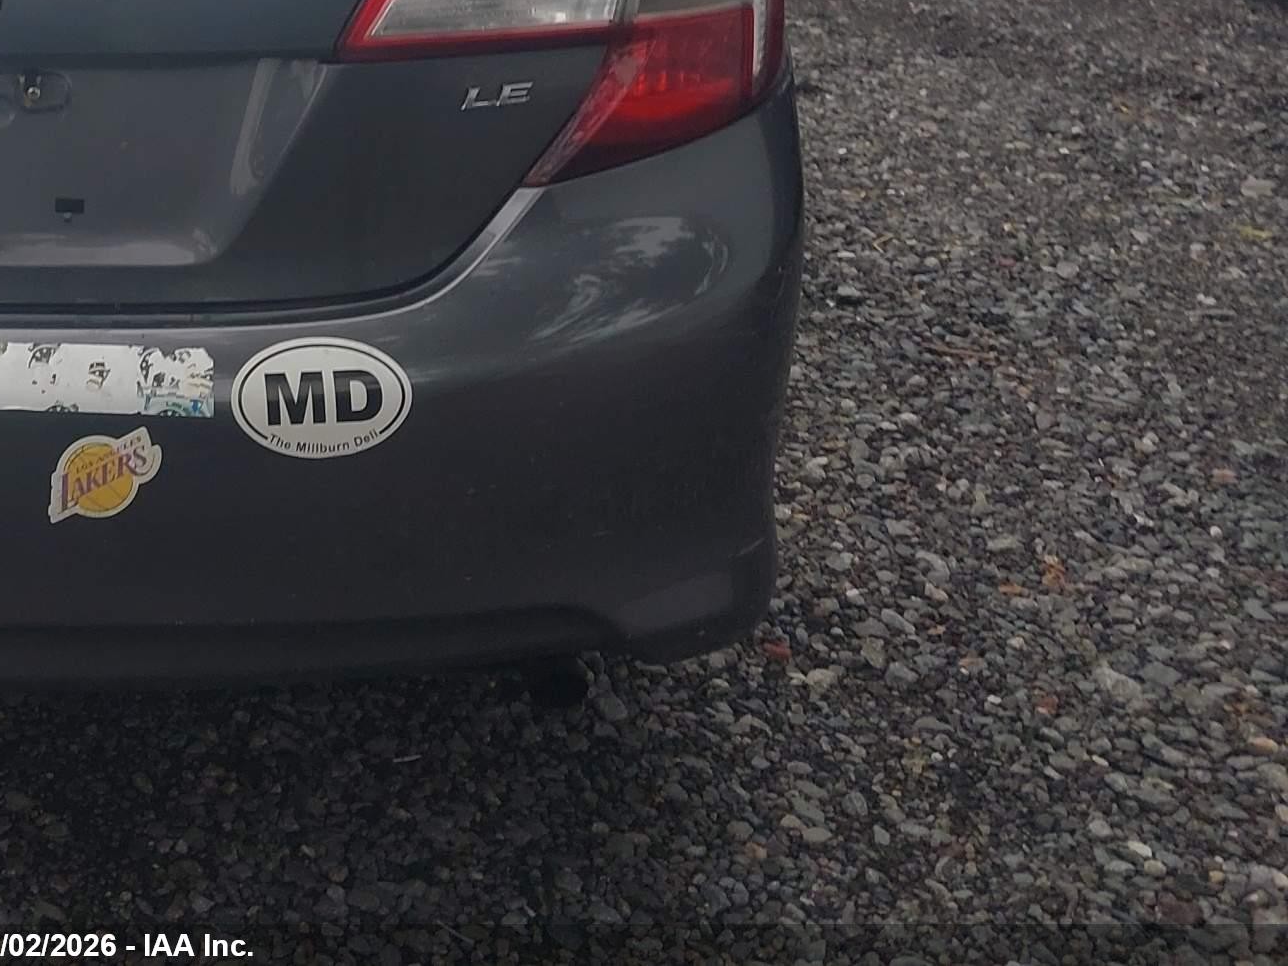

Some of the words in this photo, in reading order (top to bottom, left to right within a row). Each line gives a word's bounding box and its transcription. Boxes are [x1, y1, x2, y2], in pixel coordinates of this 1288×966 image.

[461, 81, 533, 111] LE
[263, 369, 383, 426] MD
[268, 434, 291, 449] The
[295, 441, 350, 454] Millburn
[58, 447, 150, 514] LAKERS
